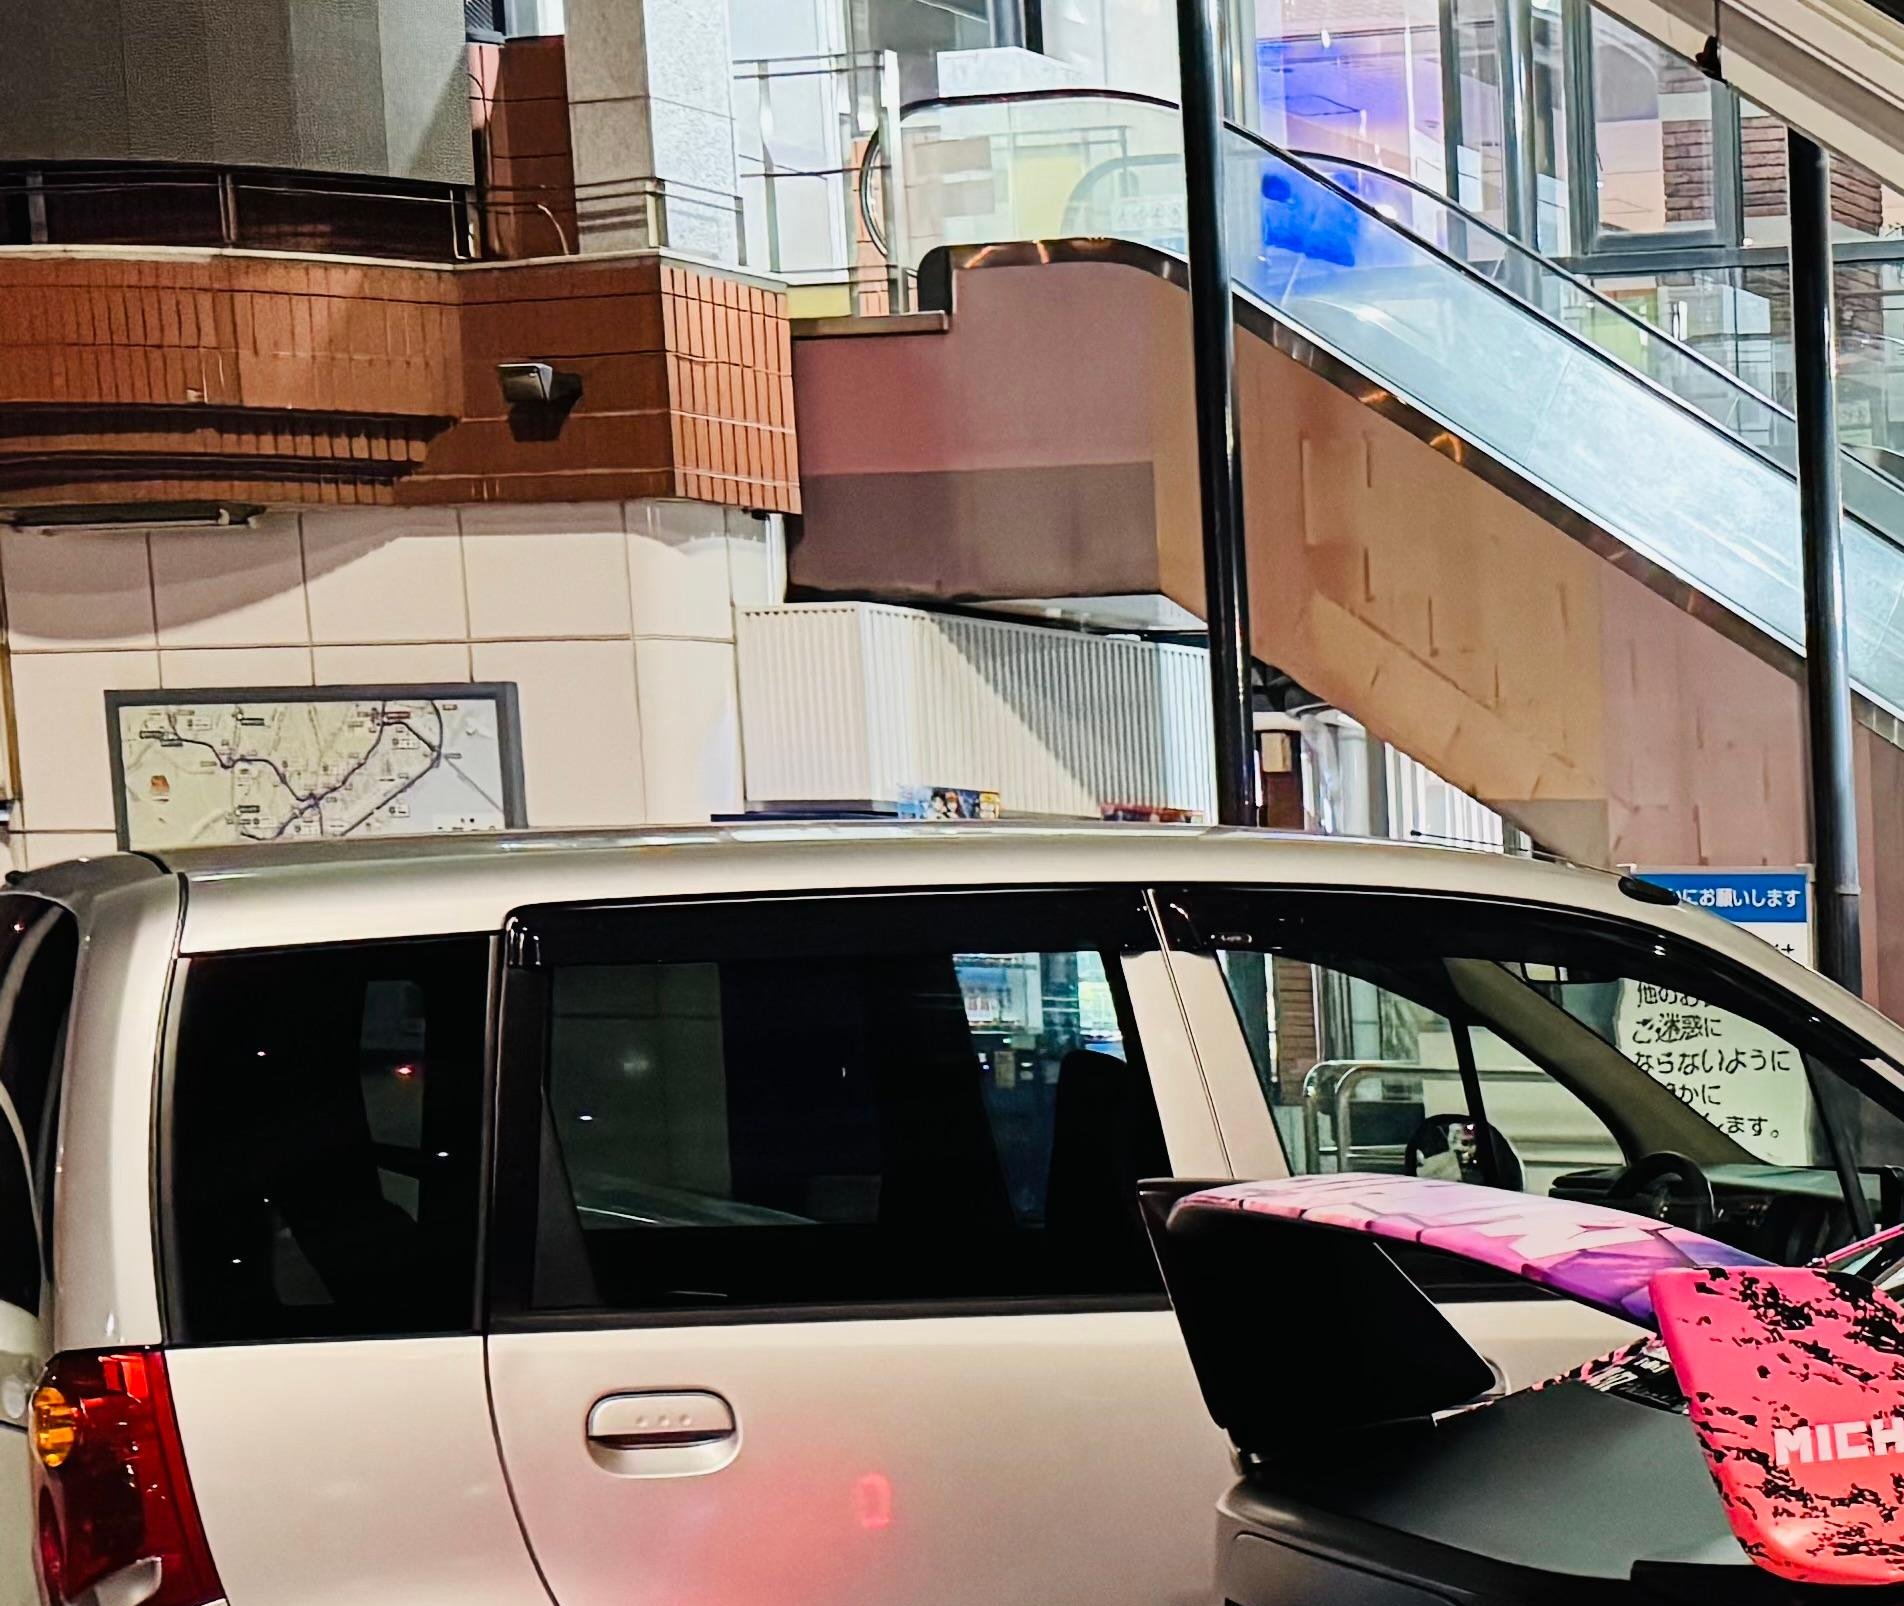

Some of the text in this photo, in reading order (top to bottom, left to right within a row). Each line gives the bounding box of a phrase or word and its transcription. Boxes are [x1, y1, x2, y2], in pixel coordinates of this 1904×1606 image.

[1673, 887, 1801, 908] にお願いします
[1632, 1013, 1722, 1044] ご迷惑に
[1635, 1049, 1791, 1075] ならないように
